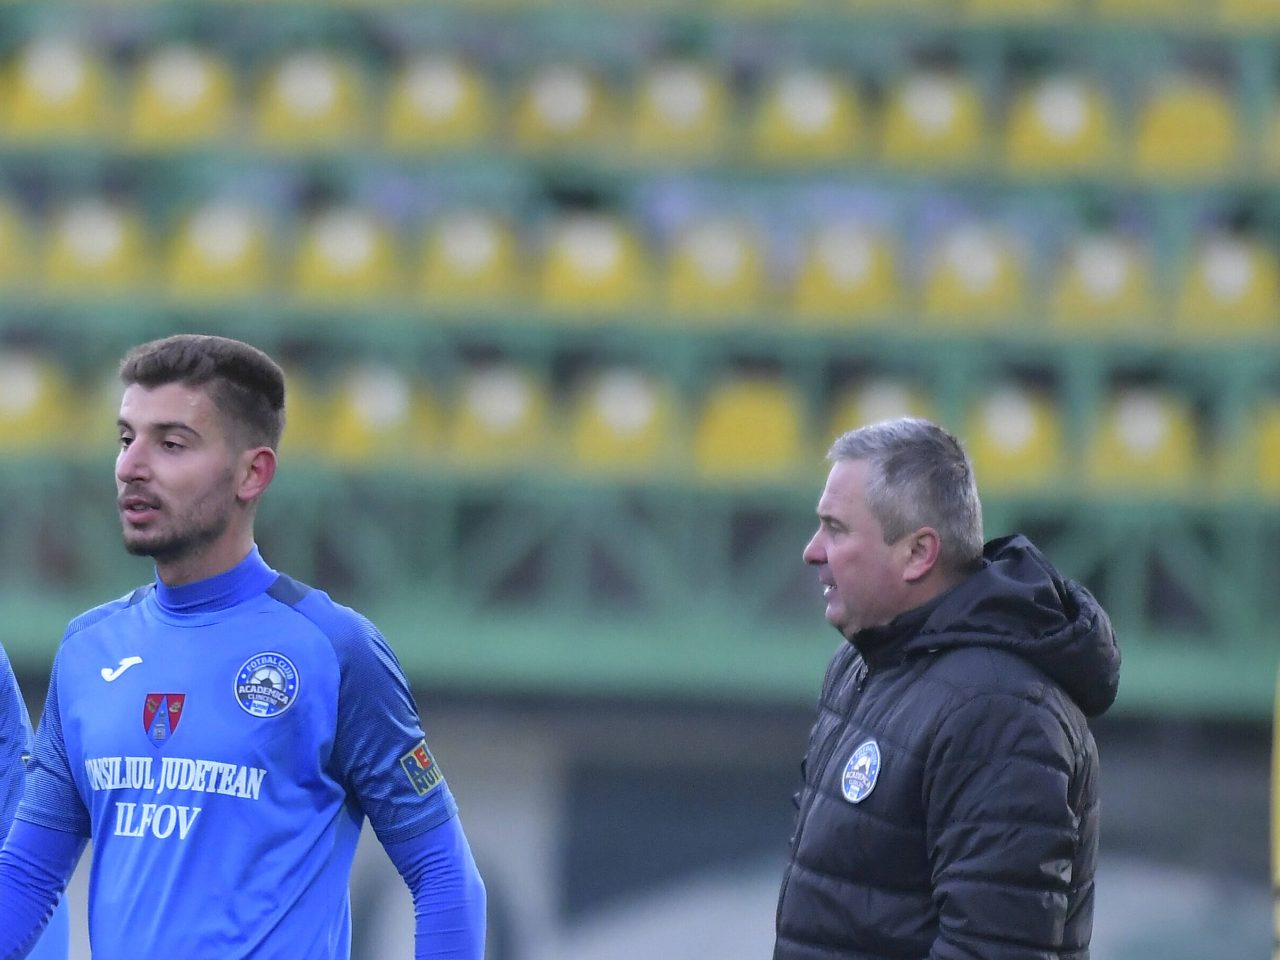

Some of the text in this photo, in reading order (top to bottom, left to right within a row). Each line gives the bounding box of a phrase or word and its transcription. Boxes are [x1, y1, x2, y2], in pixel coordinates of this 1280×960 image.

[246, 656, 294, 680] FOTBAL CLUB
[239, 685, 289, 705] ACADEMICA
[85, 756, 267, 801] ONSILIUL JUDETEAN
[114, 802, 202, 840] ILFOV
